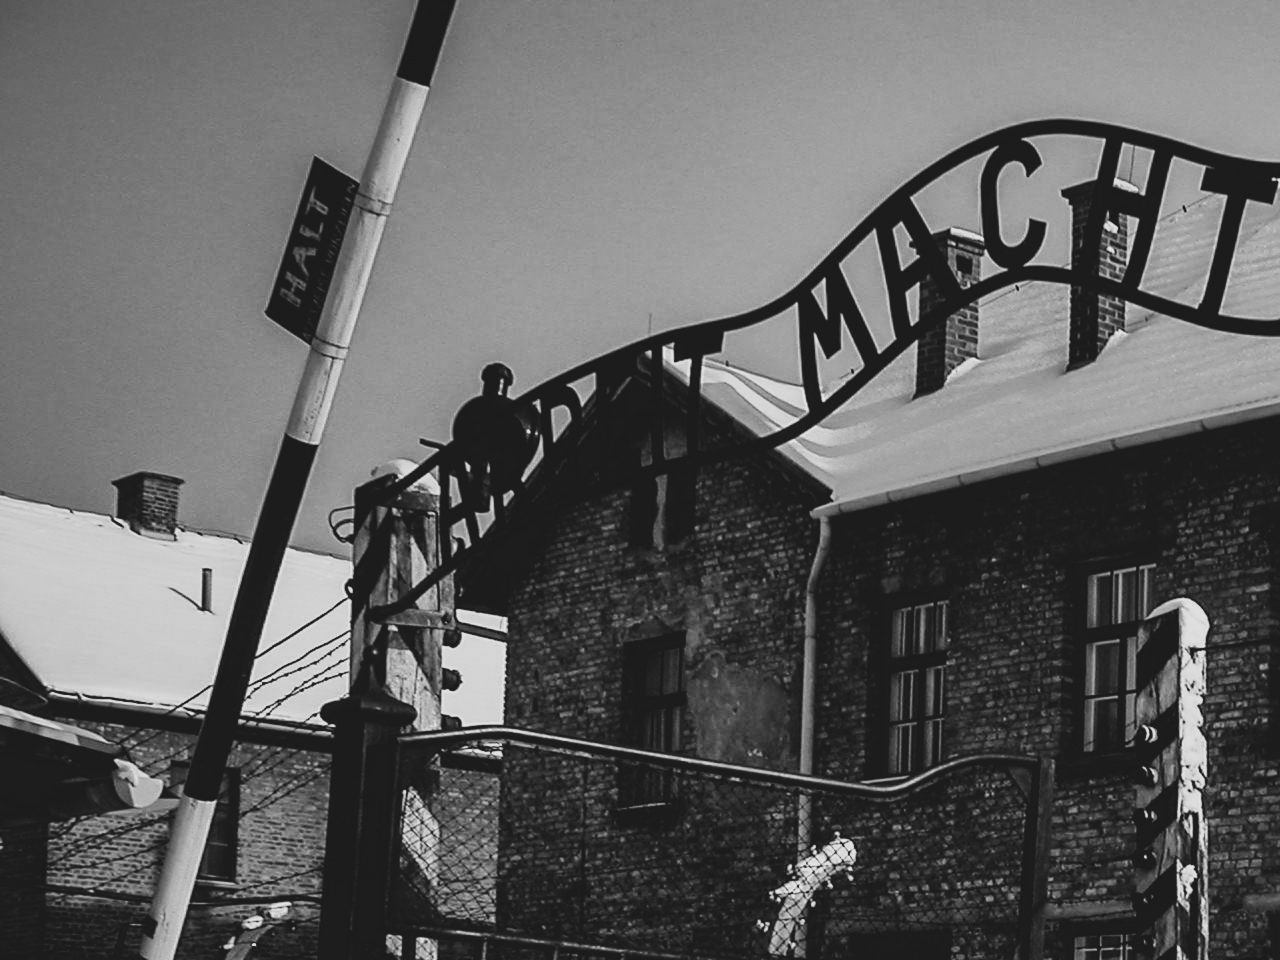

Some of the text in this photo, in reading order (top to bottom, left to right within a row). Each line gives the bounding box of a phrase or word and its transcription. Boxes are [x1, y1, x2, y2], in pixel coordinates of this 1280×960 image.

[279, 185, 329, 308] HALT
[438, 322, 725, 567] ABIT
[796, 128, 1277, 413] MACHT
